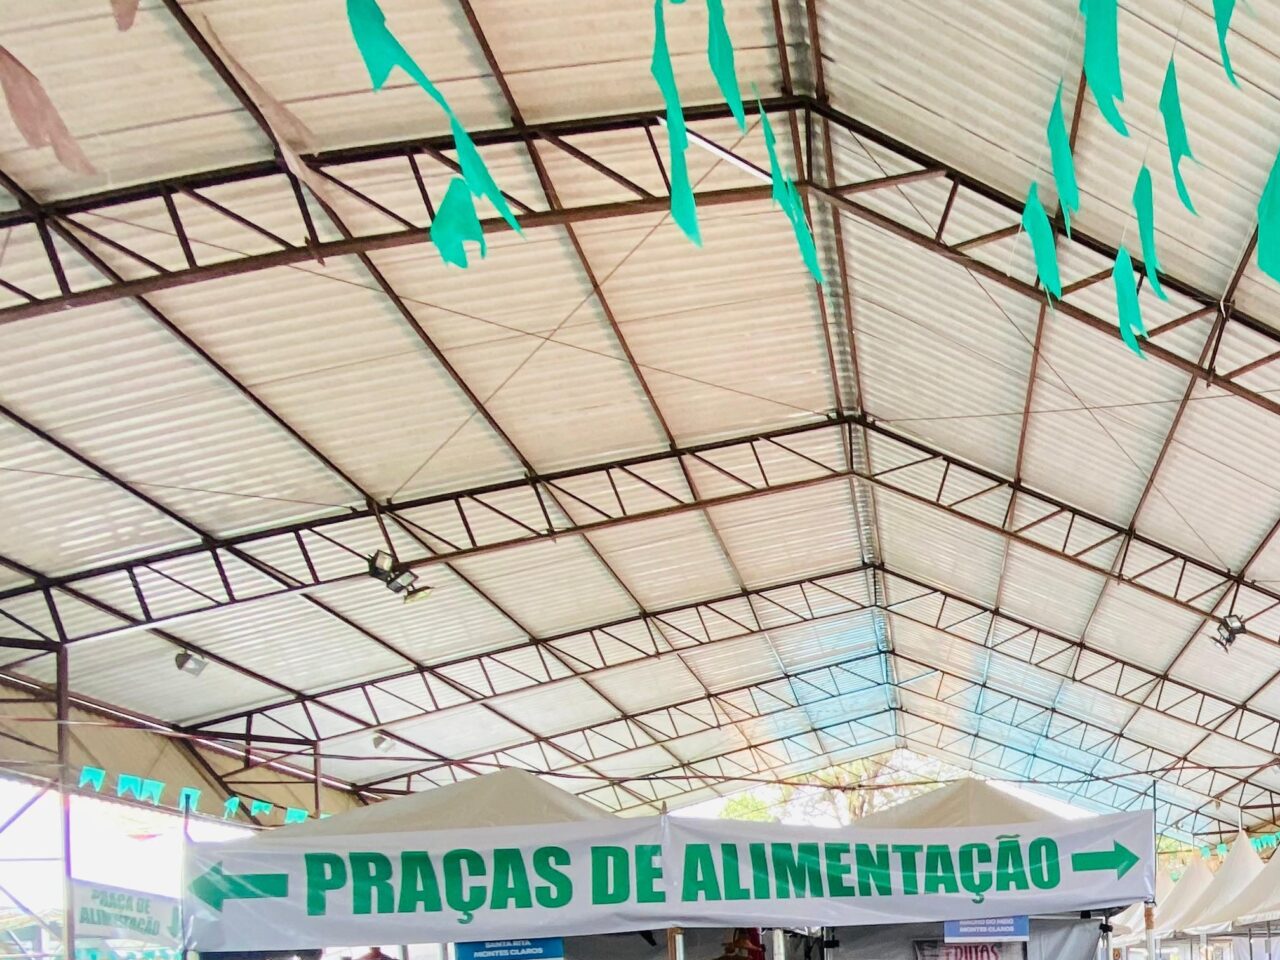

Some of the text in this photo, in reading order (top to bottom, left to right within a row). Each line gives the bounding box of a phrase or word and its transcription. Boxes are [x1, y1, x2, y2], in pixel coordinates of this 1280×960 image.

[304, 833, 1061, 924] PRAÇAS DE ALIMENTAÇÃO
